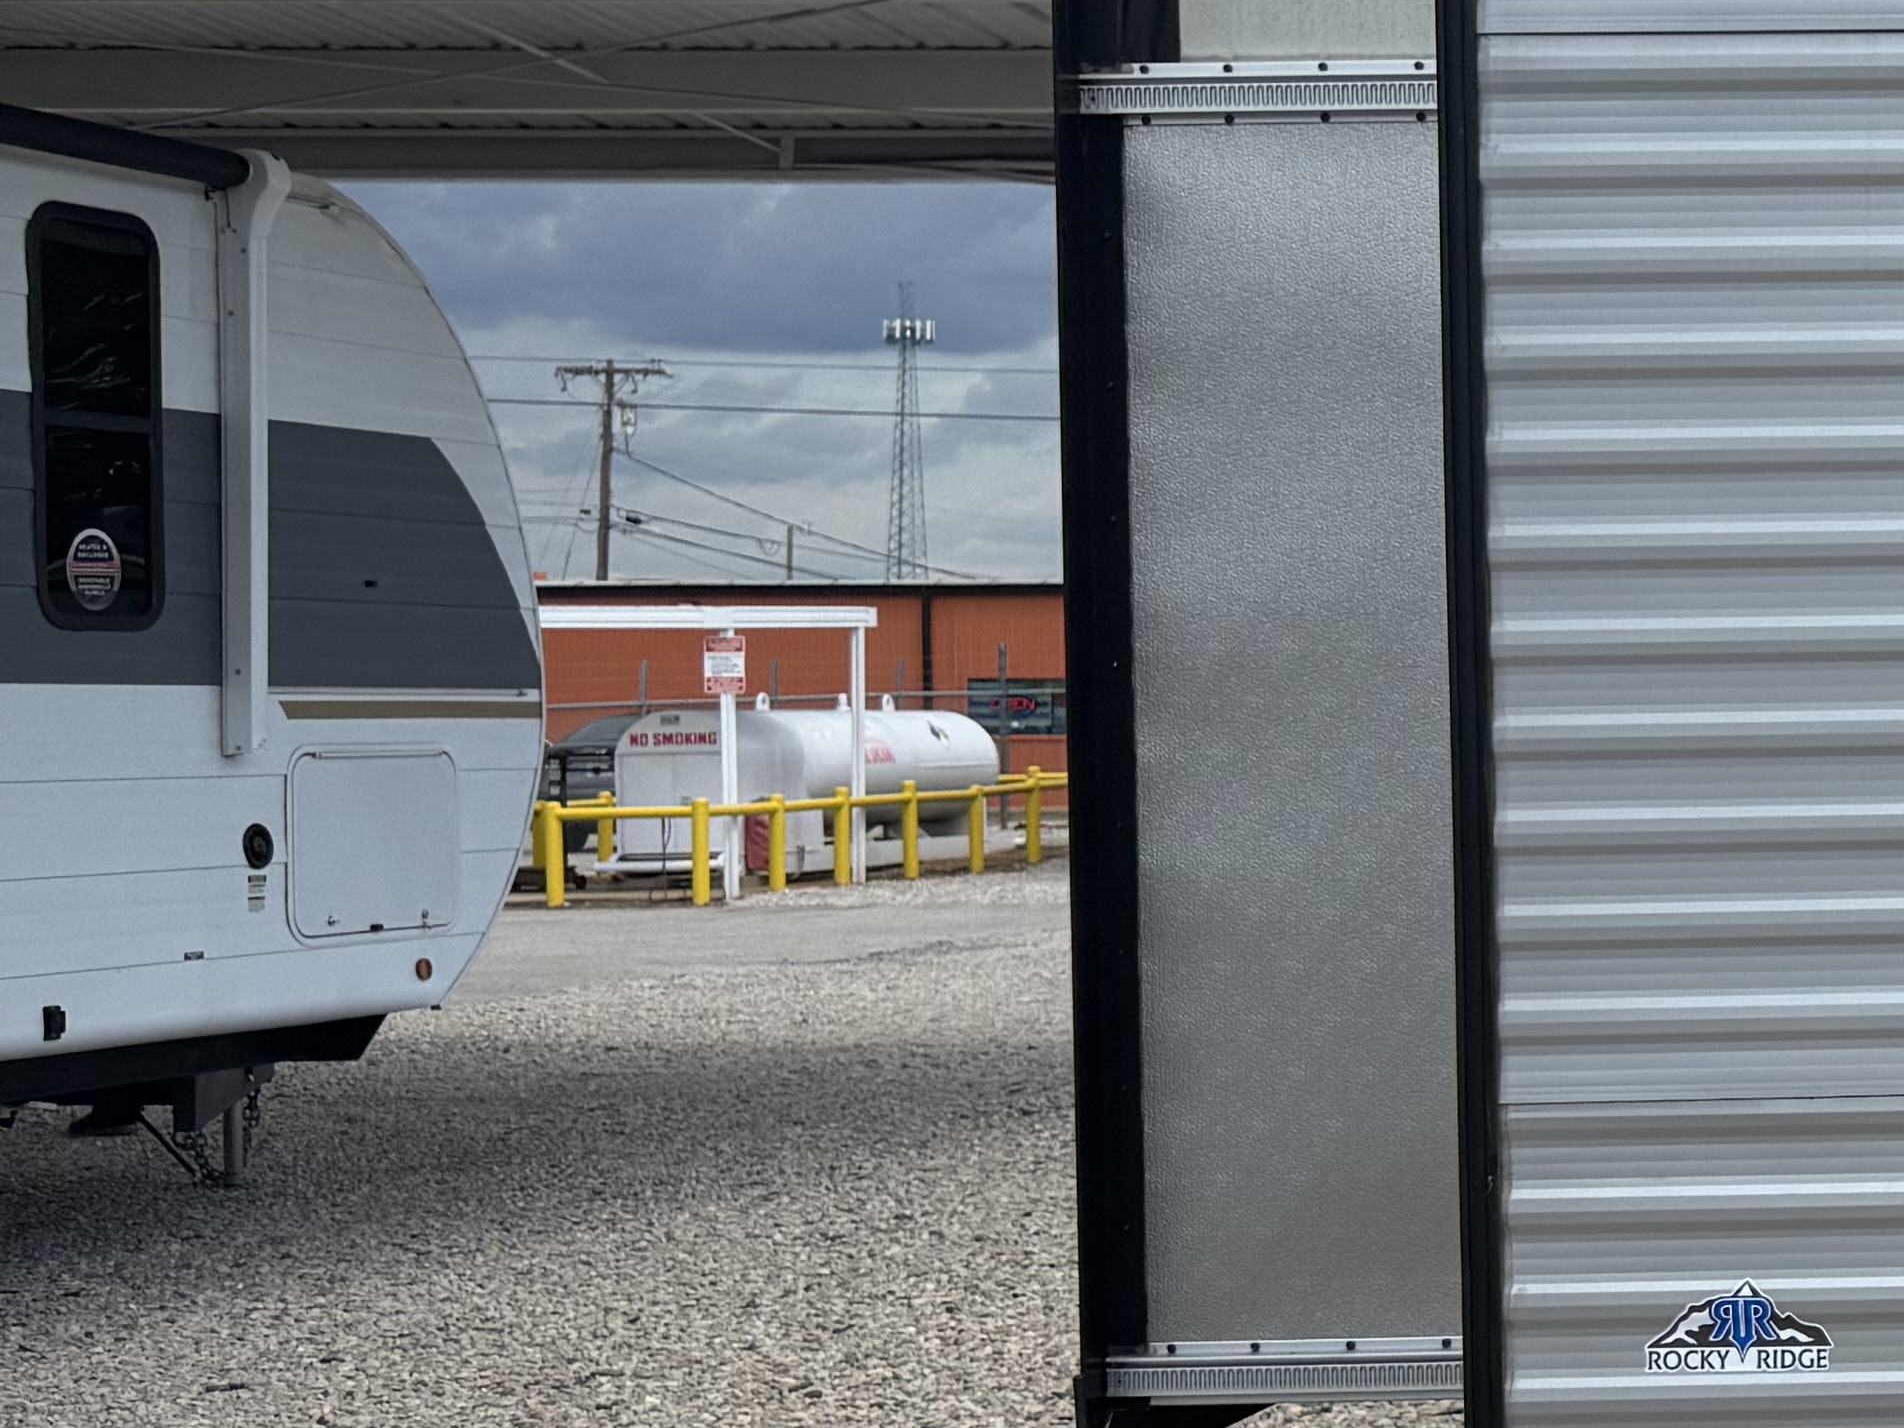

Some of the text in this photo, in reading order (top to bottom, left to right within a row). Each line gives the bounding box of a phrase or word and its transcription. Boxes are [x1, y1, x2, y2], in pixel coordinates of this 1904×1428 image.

[630, 731, 717, 747] NO SMOKING
[1647, 1347, 1829, 1371] ROCKY RIDGE
